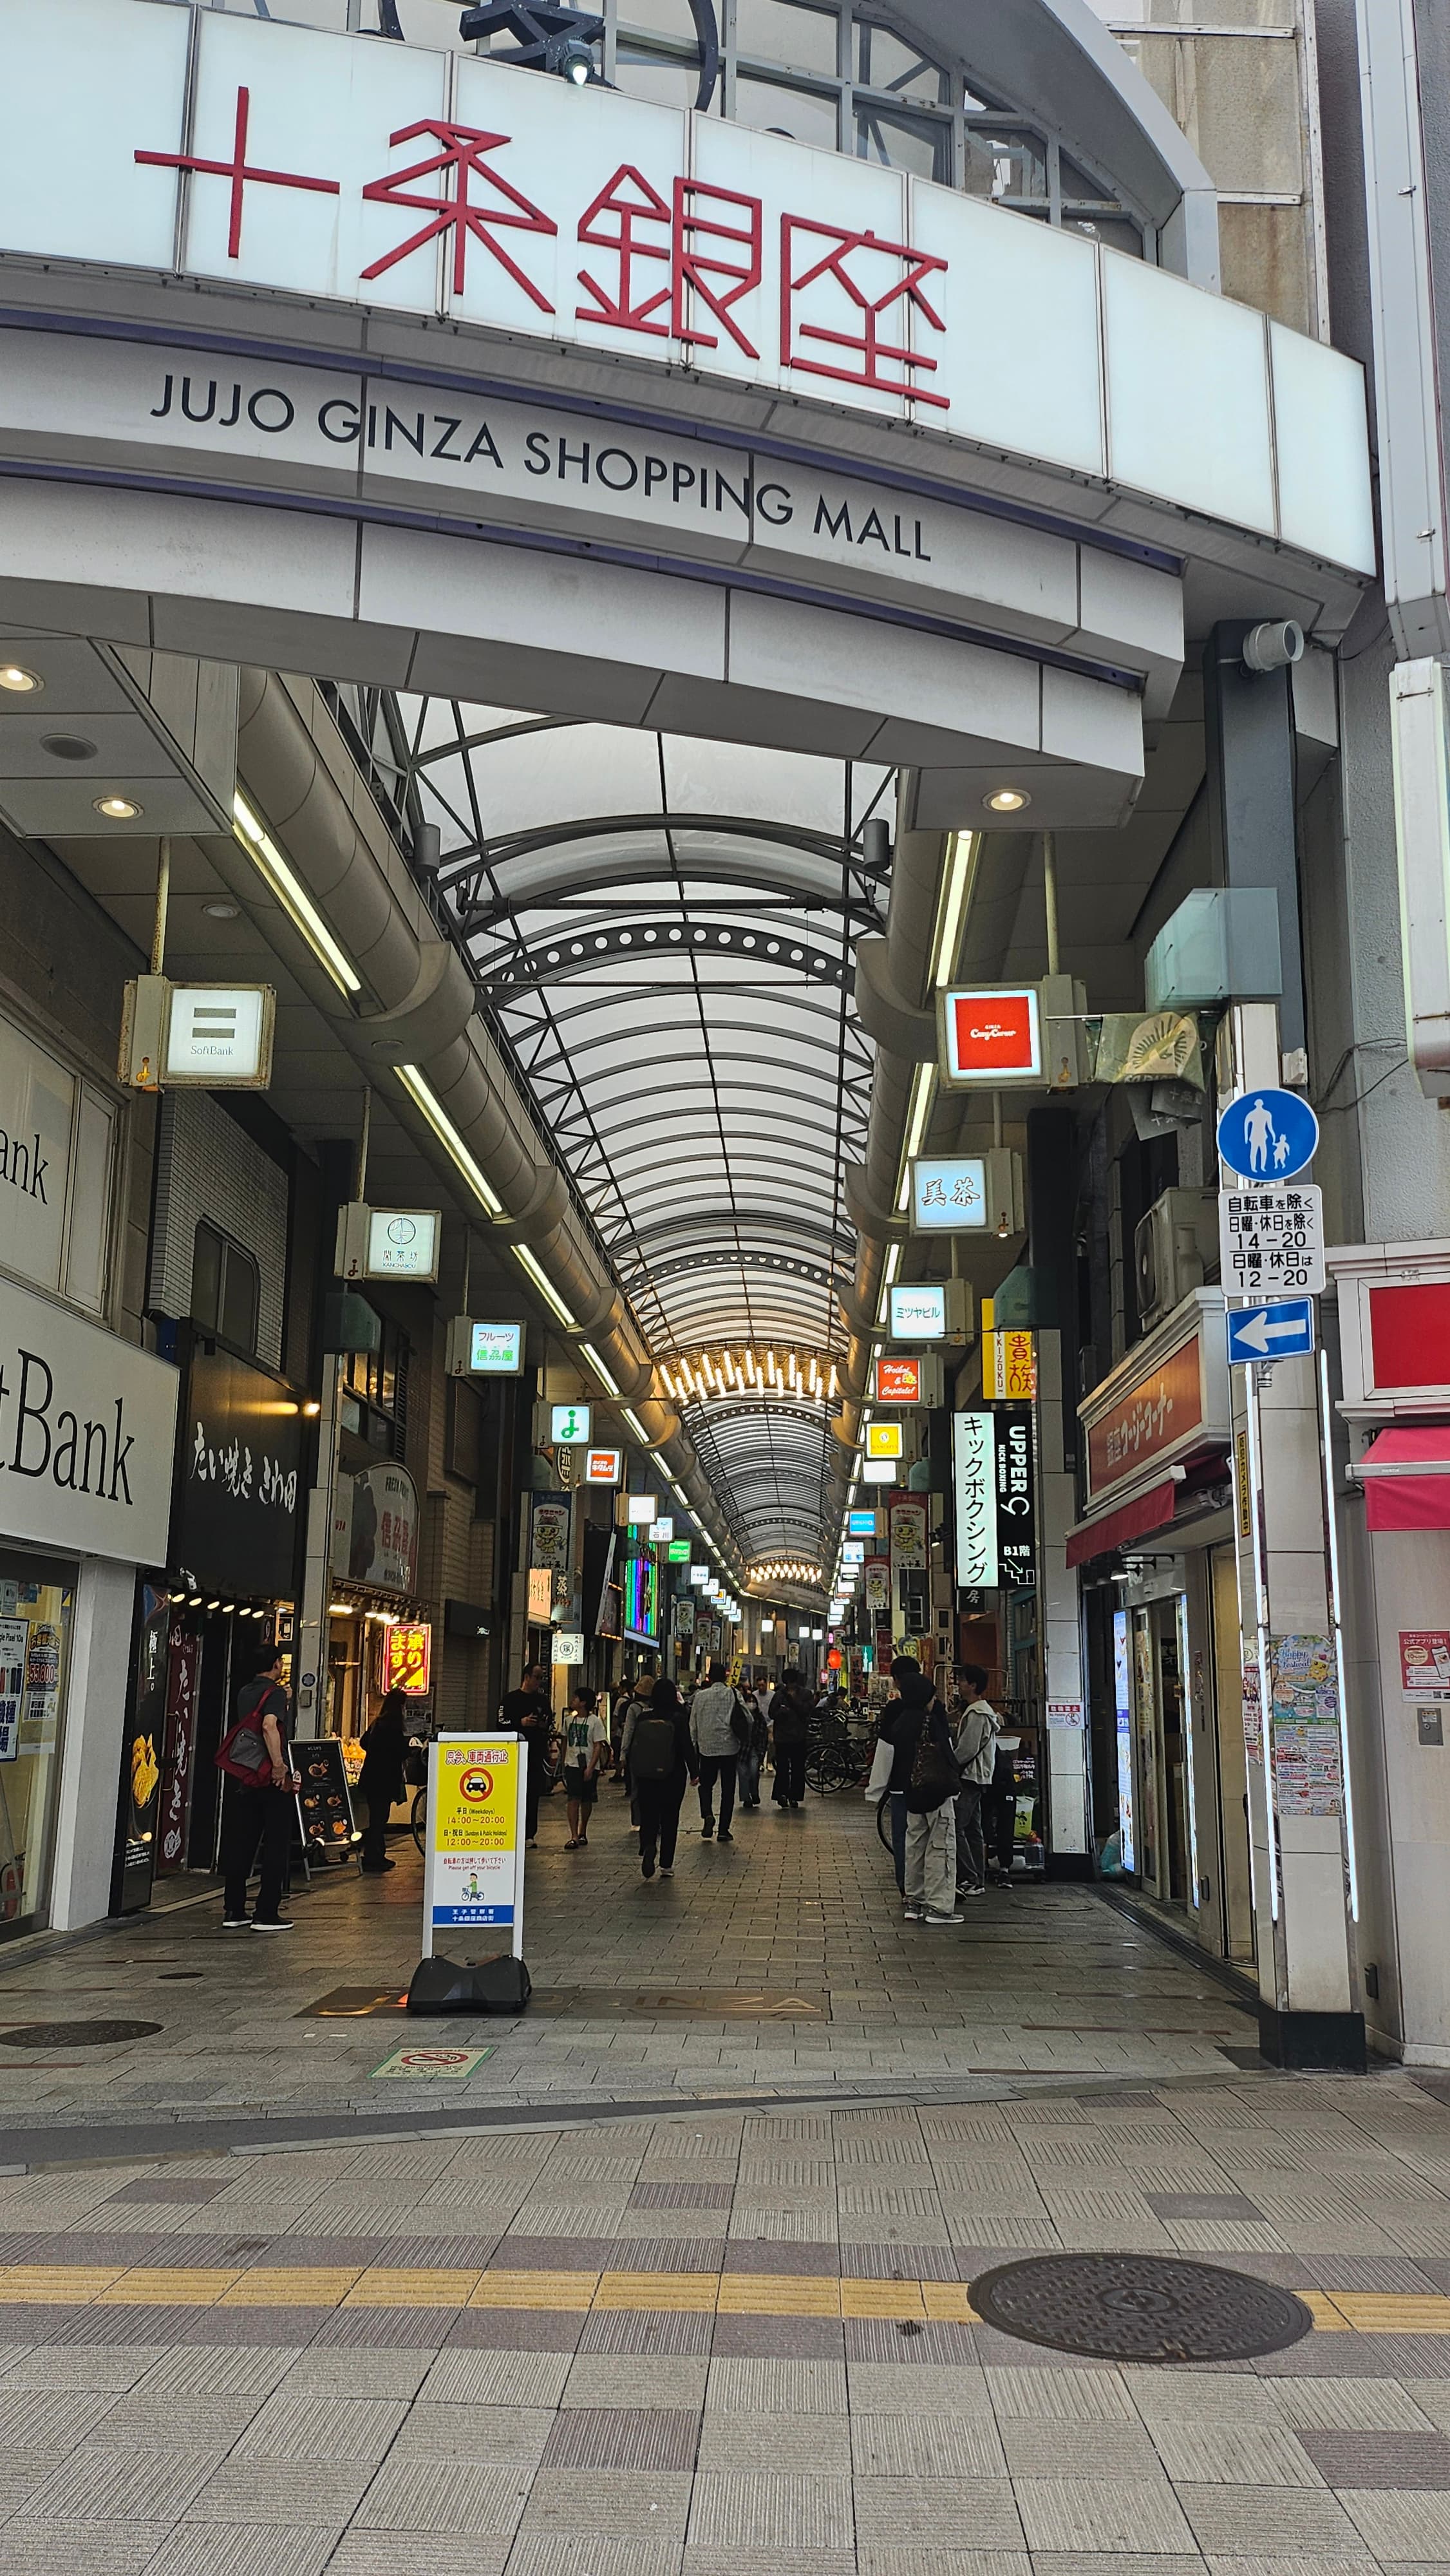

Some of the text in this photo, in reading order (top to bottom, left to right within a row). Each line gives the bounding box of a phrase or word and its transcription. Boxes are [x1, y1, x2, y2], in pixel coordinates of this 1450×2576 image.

[133, 86, 950, 410] 十条銀座
[150, 374, 932, 562] JUJO GINZA SHOPPING MALL
[191, 1045, 234, 1056] SoftBank
[1228, 1193, 1314, 1212] 自転車を除く
[1229, 1213, 1314, 1233] 日曜・休日を除く
[1232, 1251, 1313, 1269] 日曜・休日は
[478, 1332, 514, 1342] フルーツ
[1008, 1425, 1028, 1493] UPPER
[963, 1416, 988, 1584] キックボクシング
[1003, 1546, 1030, 1557] B1階
[446, 1749, 509, 1765] 只今、車両通行止
[457, 1806, 467, 1815] 平日
